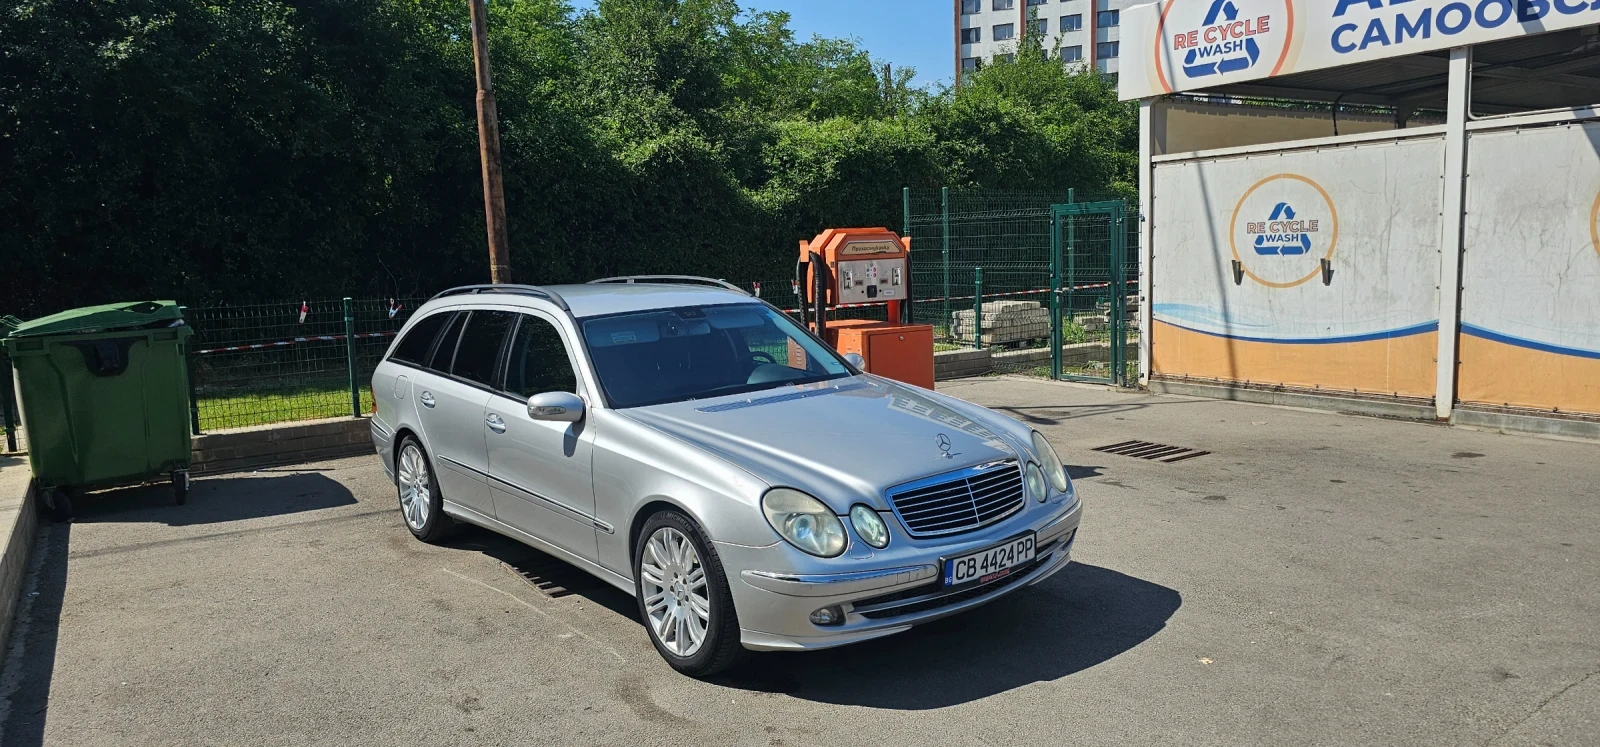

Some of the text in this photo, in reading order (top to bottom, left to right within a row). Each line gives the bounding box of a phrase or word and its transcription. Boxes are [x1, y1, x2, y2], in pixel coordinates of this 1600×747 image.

[1174, 15, 1270, 50] RE CYCLE
[1198, 40, 1243, 58] WASH
[1247, 219, 1319, 234] RE CYCLE
[1265, 234, 1299, 242] WASH
[955, 557, 977, 580] CB
[980, 544, 1015, 573] 4424
